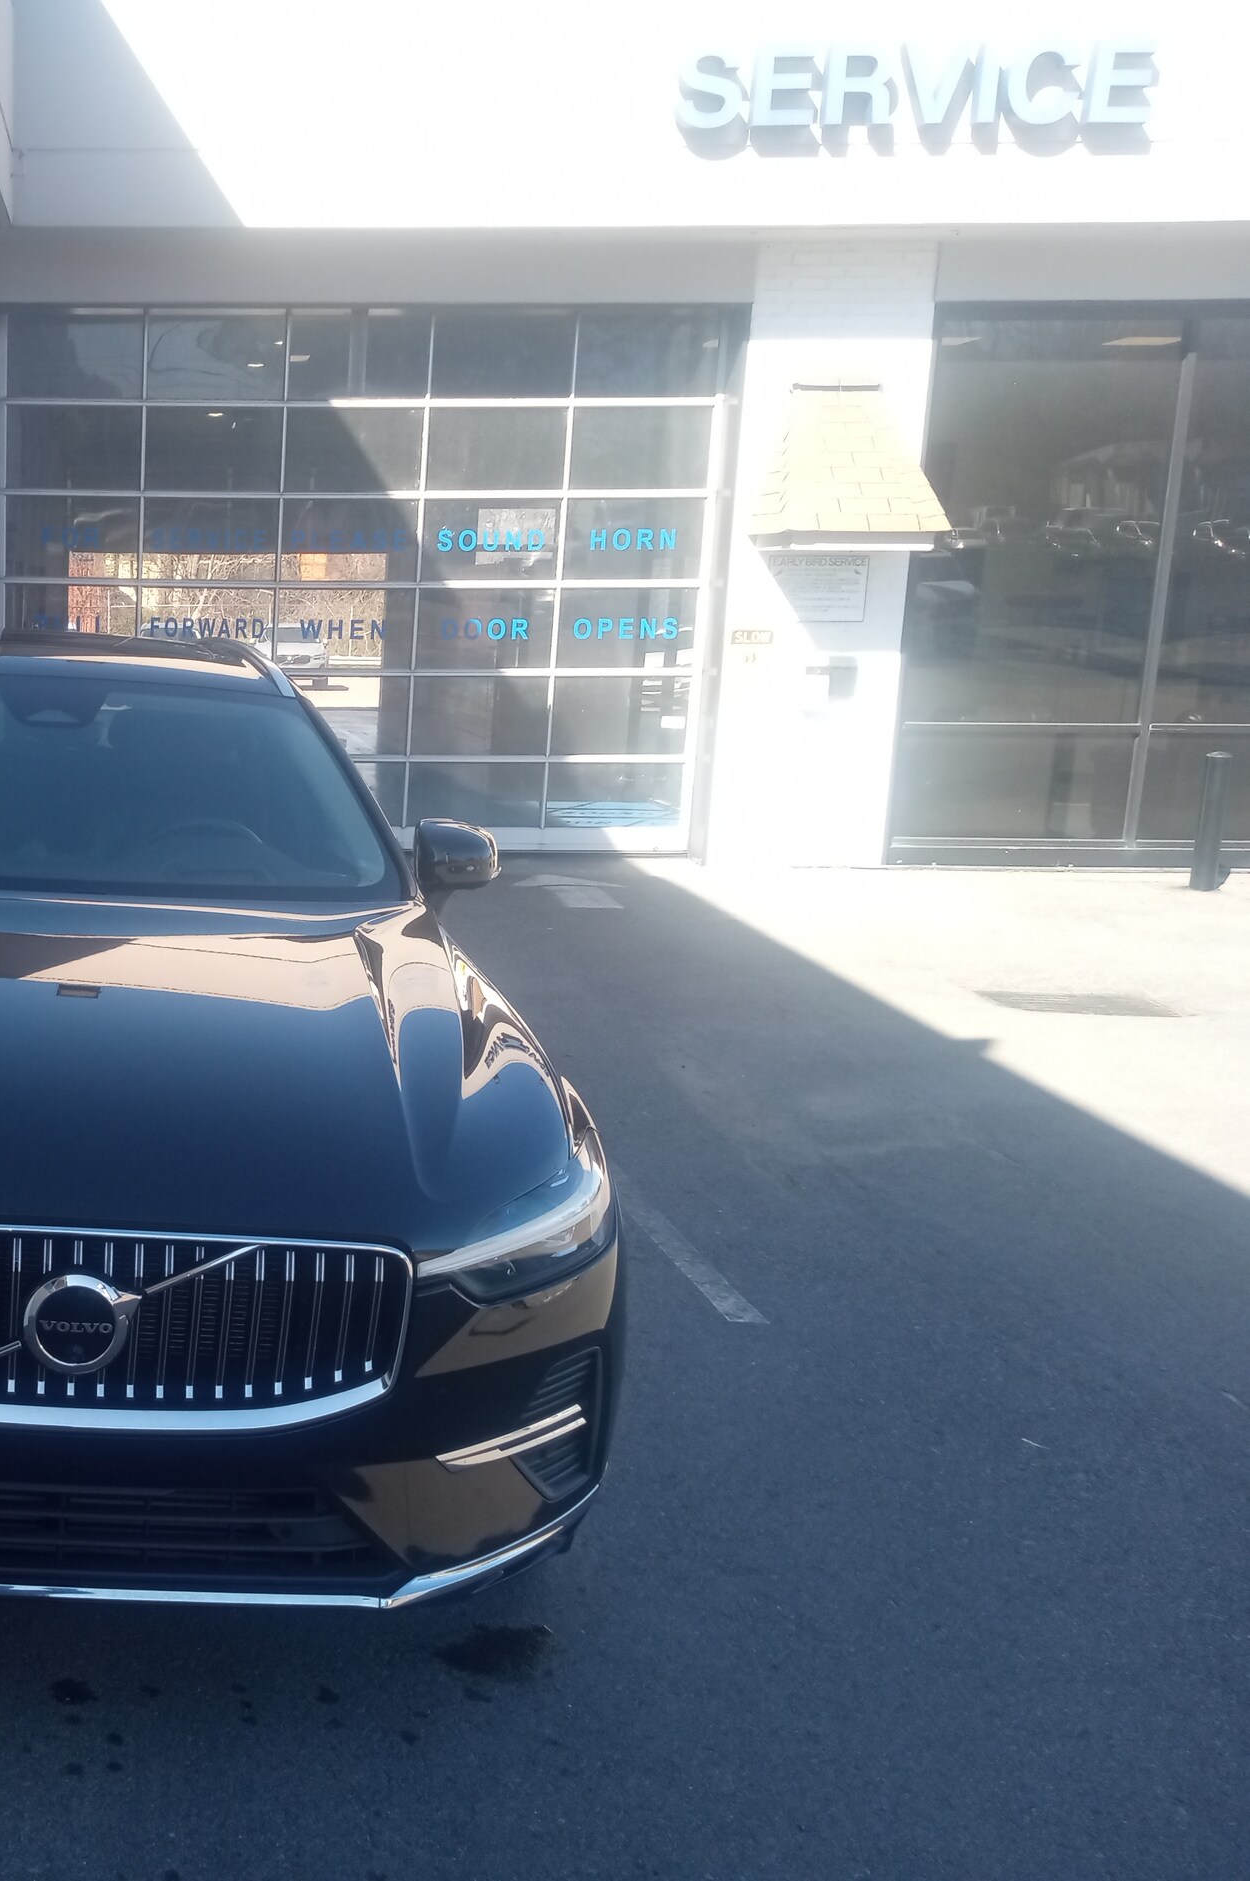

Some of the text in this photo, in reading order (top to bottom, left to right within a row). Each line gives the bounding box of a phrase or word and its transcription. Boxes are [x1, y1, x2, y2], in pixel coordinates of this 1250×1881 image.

[676, 40, 1160, 158] SERVICE
[41, 526, 677, 553] FOR SERVICE PLEASE SOUND HORN
[773, 557, 867, 567] EARLY BIRD SERVICE
[150, 616, 266, 640] FORWARD
[300, 618, 387, 641] WHEN
[441, 617, 529, 641] DOOR
[573, 617, 679, 641] OPENS
[733, 630, 772, 644] SLOW
[38, 1319, 114, 1334] VOLVO
